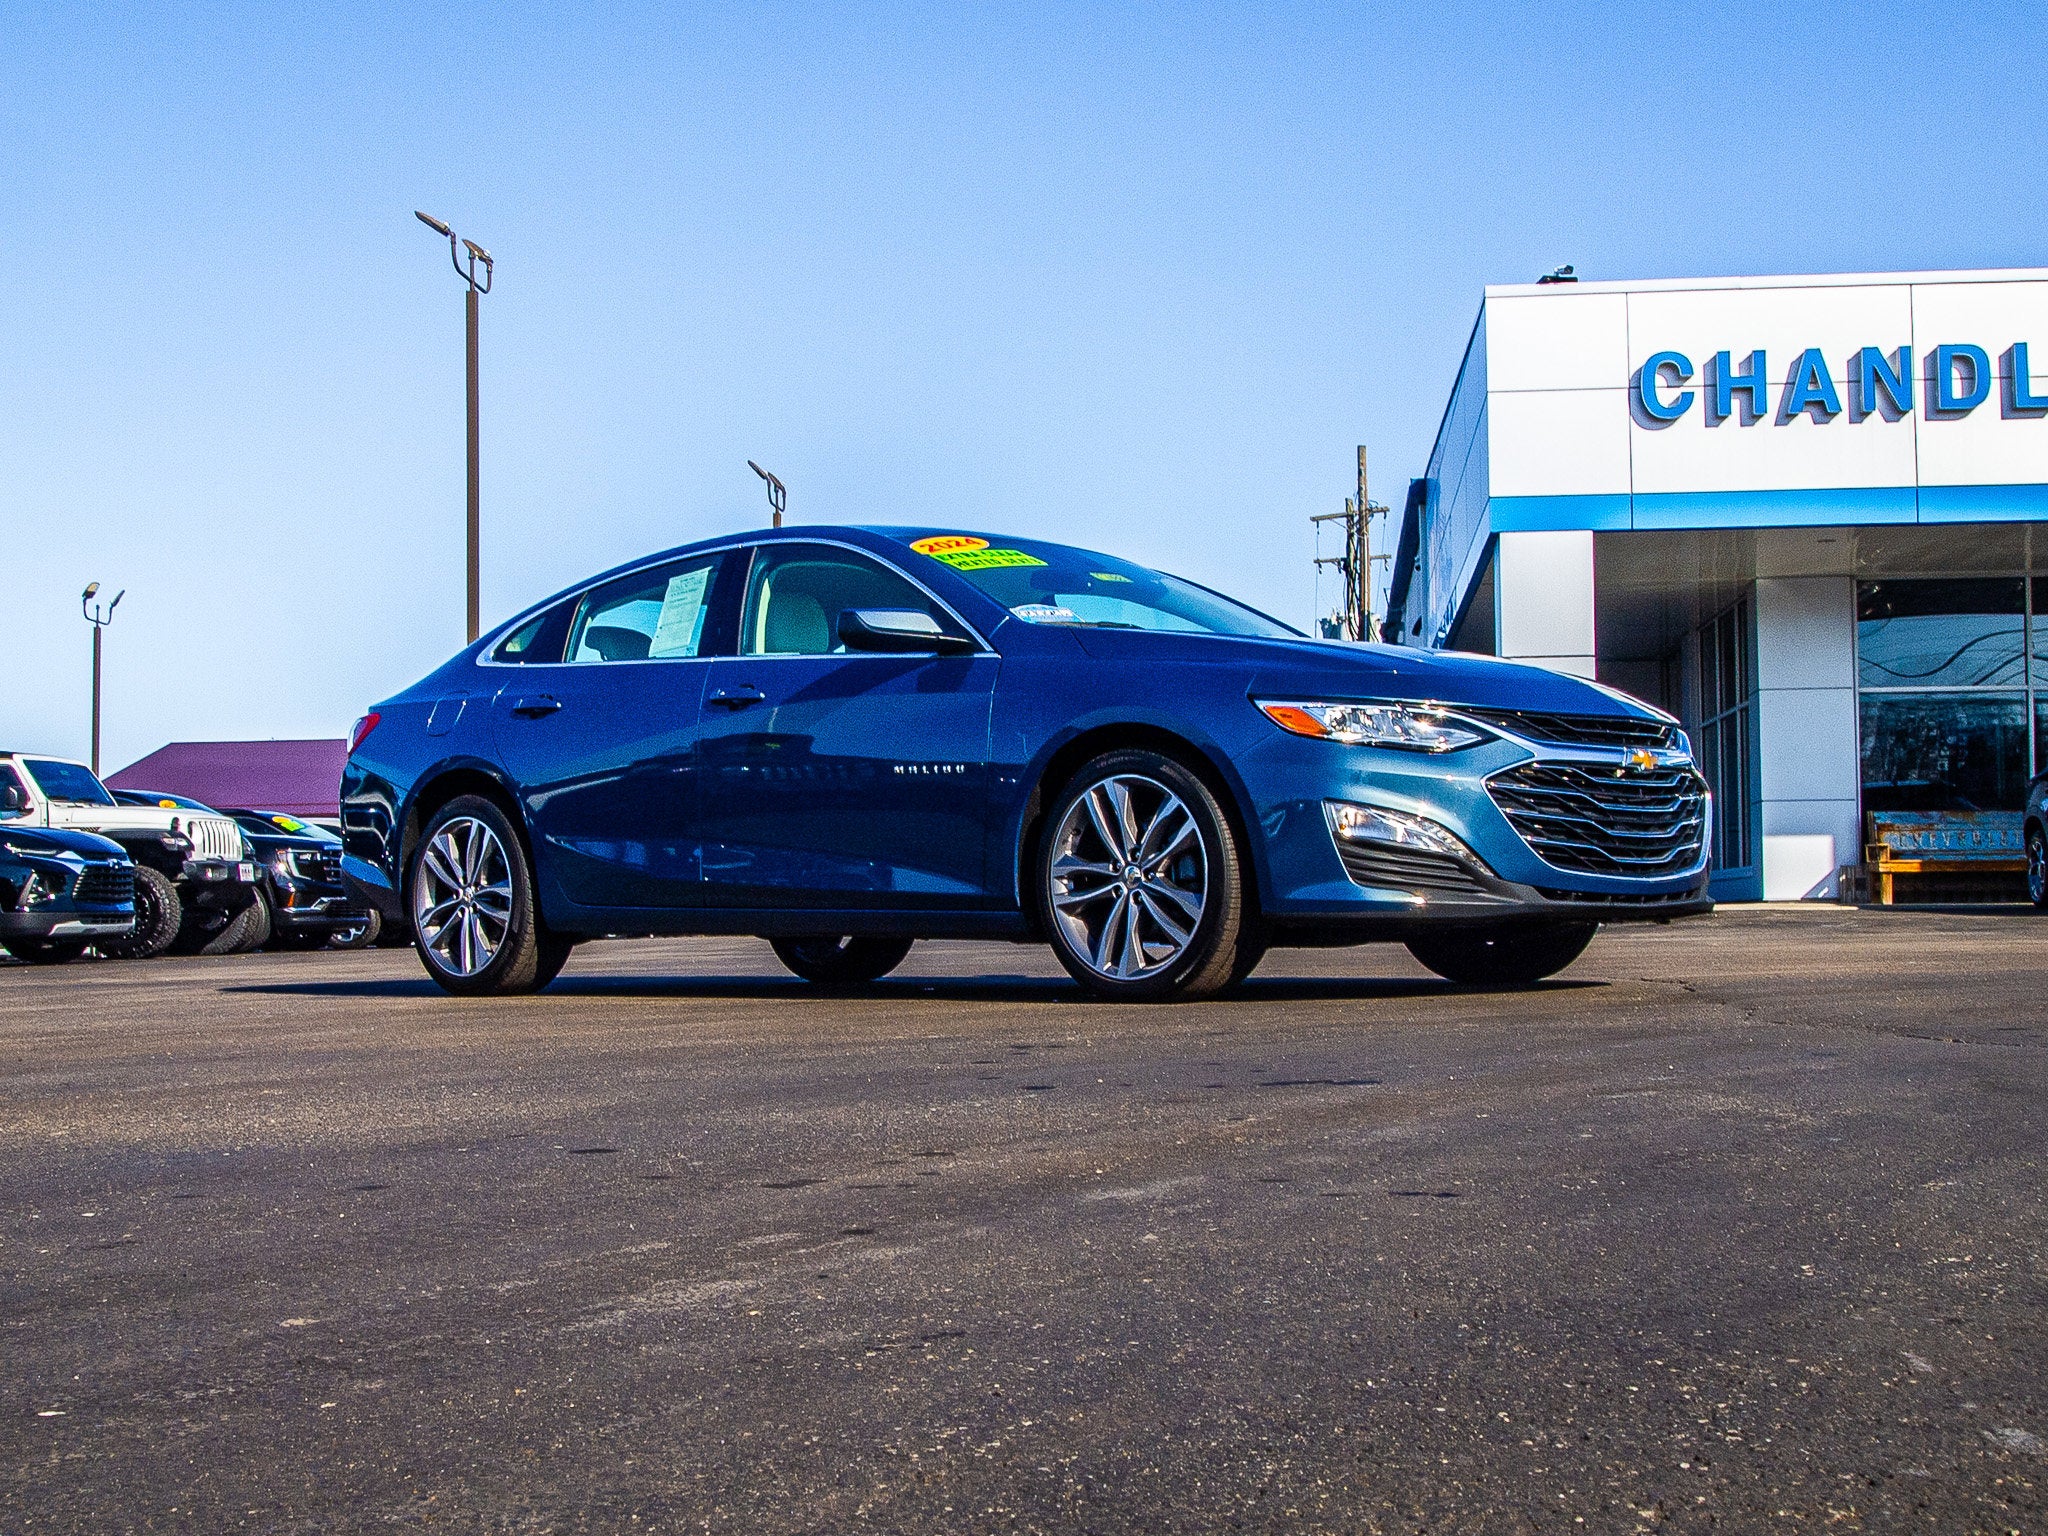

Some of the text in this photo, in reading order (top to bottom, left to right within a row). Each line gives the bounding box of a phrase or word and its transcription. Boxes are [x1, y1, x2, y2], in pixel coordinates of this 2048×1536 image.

[1640, 342, 2048, 420] CHANDL
[919, 537, 981, 553] 2024
[894, 765, 964, 774] MALIBU
